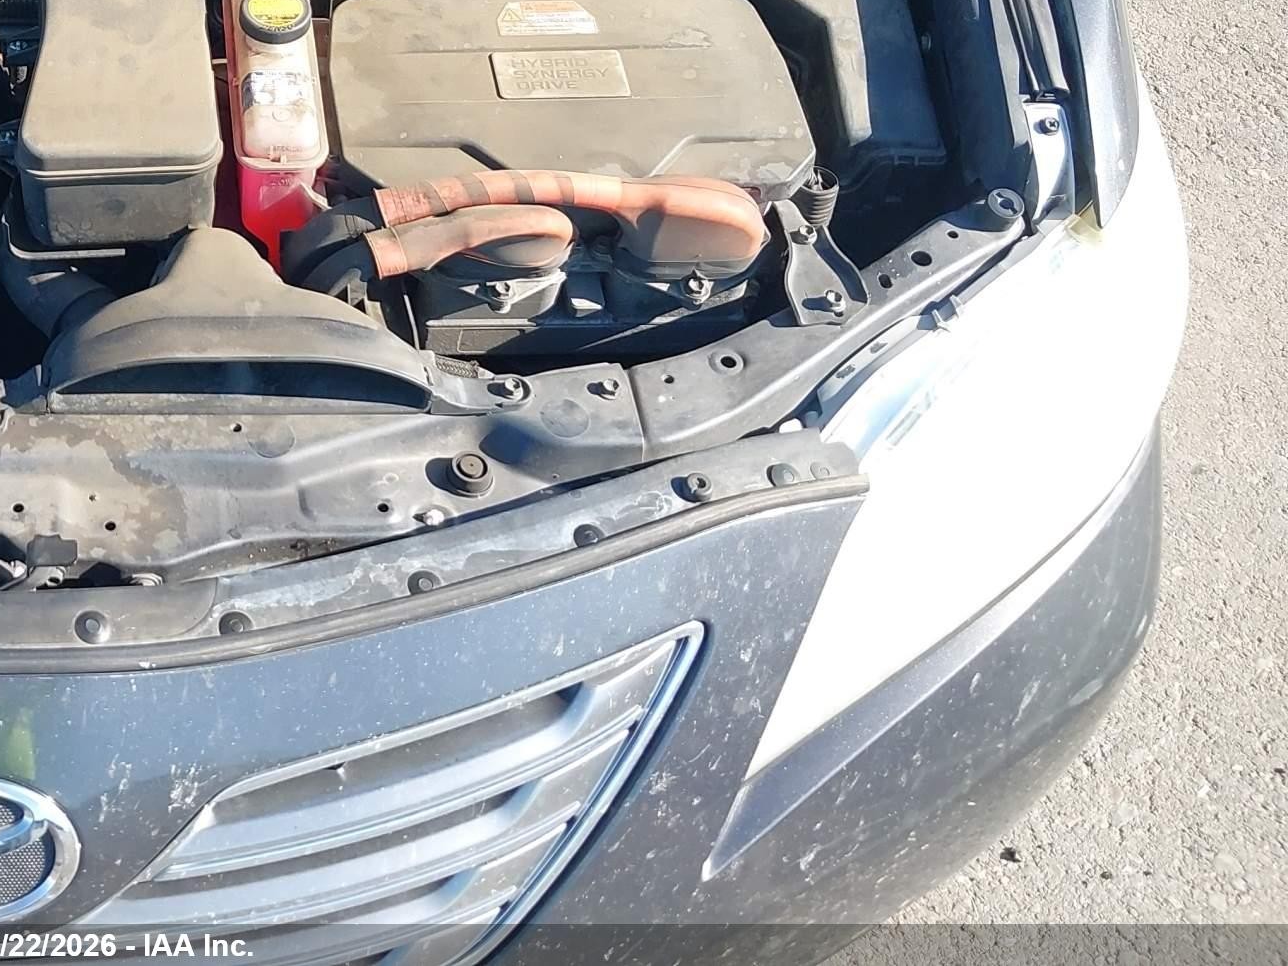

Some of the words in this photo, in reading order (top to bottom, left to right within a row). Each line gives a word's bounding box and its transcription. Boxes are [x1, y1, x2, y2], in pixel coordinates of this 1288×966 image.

[510, 57, 589, 68] HYBRID
[512, 67, 610, 79] SYNERGY
[516, 80, 578, 90] DRIVE
